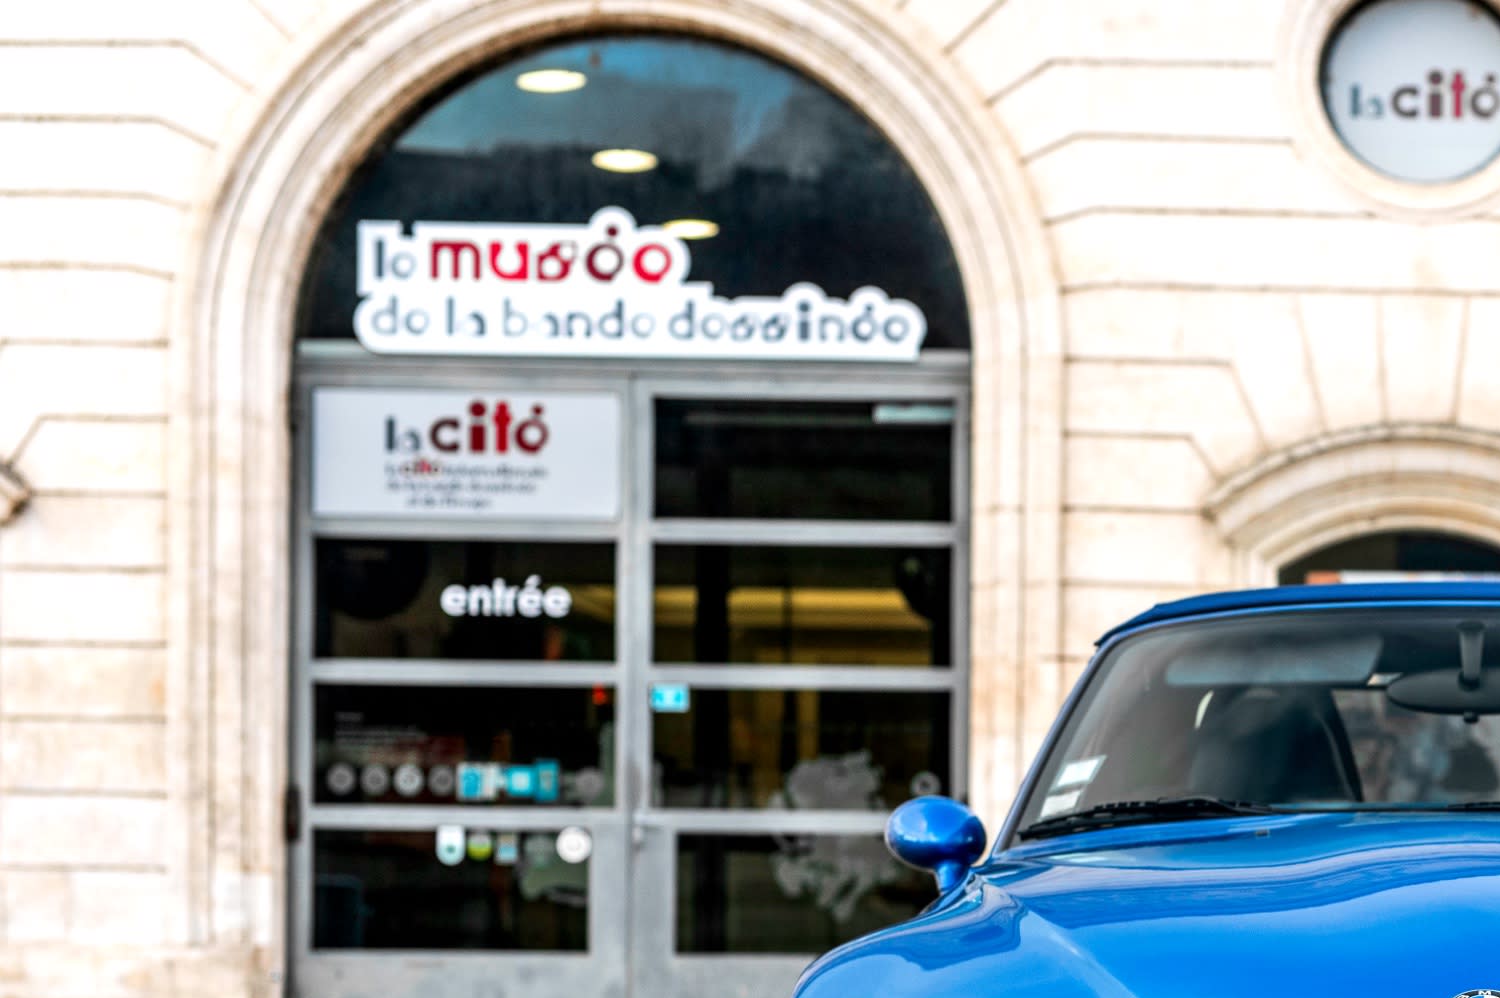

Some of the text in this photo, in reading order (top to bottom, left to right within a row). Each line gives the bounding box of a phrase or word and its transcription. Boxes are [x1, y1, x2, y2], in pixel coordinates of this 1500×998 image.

[1391, 69, 1500, 120] cité
[446, 296, 487, 336] la
[429, 400, 549, 455] cité
[440, 574, 572, 618] entrée
